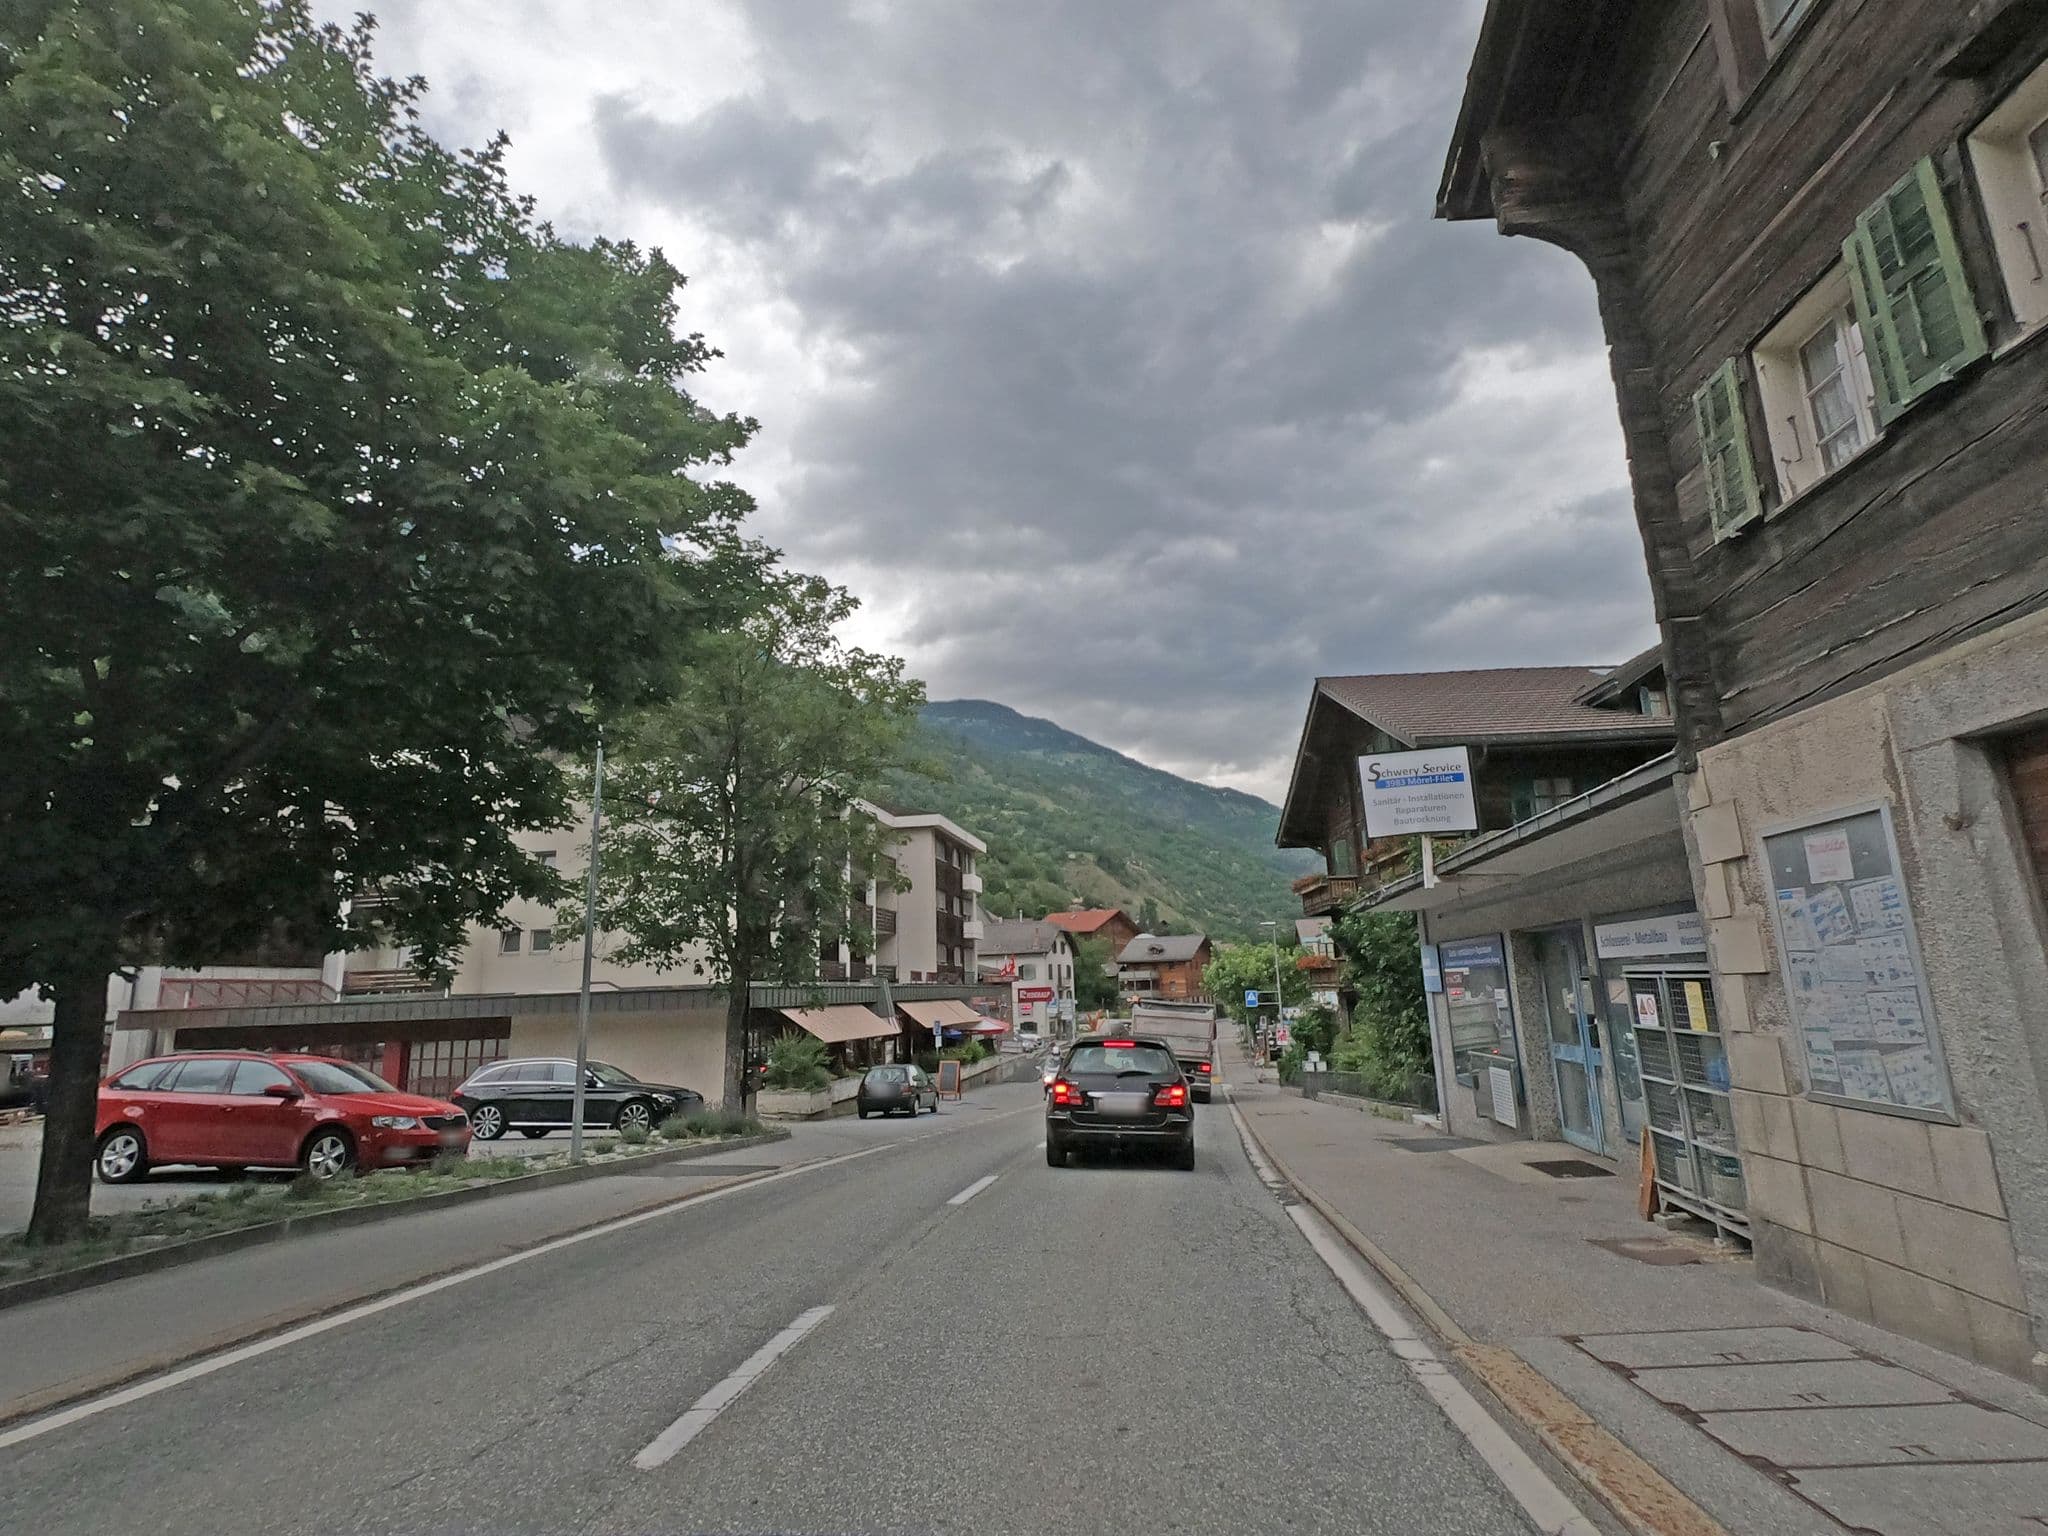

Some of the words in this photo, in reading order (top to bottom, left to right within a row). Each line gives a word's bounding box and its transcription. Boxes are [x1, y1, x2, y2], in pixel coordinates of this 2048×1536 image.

[1368, 763, 1420, 782] Schwery
[1422, 763, 1462, 774] Service
[1385, 779, 1406, 788] 3983
[1408, 792, 1465, 803] Installationen
[1395, 804, 1447, 815] Reparaturen
[1393, 815, 1451, 826] Bautrocknung
